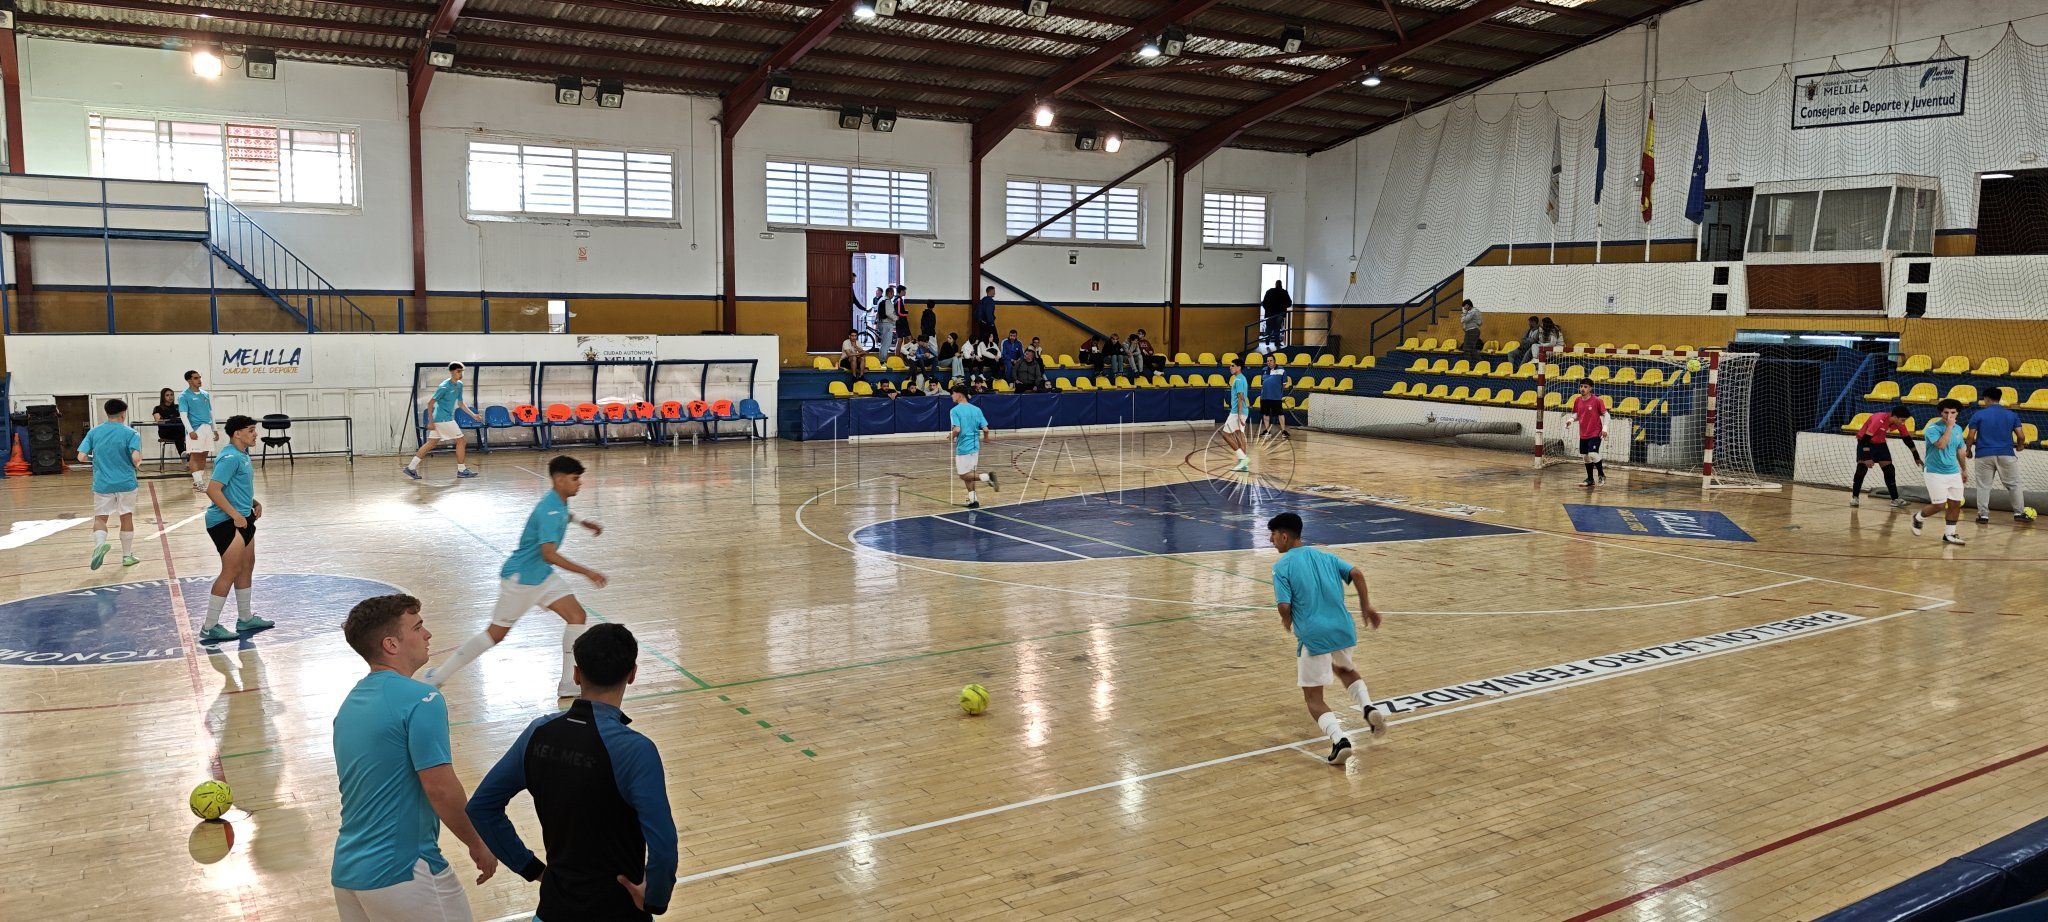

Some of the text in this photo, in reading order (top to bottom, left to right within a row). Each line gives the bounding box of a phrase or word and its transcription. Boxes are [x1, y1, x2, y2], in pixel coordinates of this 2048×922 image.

[1823, 83, 1868, 96] MELILLA
[1800, 92, 1955, 120] Consejería de Deporte y Juventud
[222, 347, 302, 367] MELILLA
[252, 367, 267, 375] DEL
[269, 366, 300, 375] DEPORTE
[1372, 612, 1848, 714] PABELLÓN LÁZARO FERNÁNDEZ
[532, 743, 582, 766] KELME
